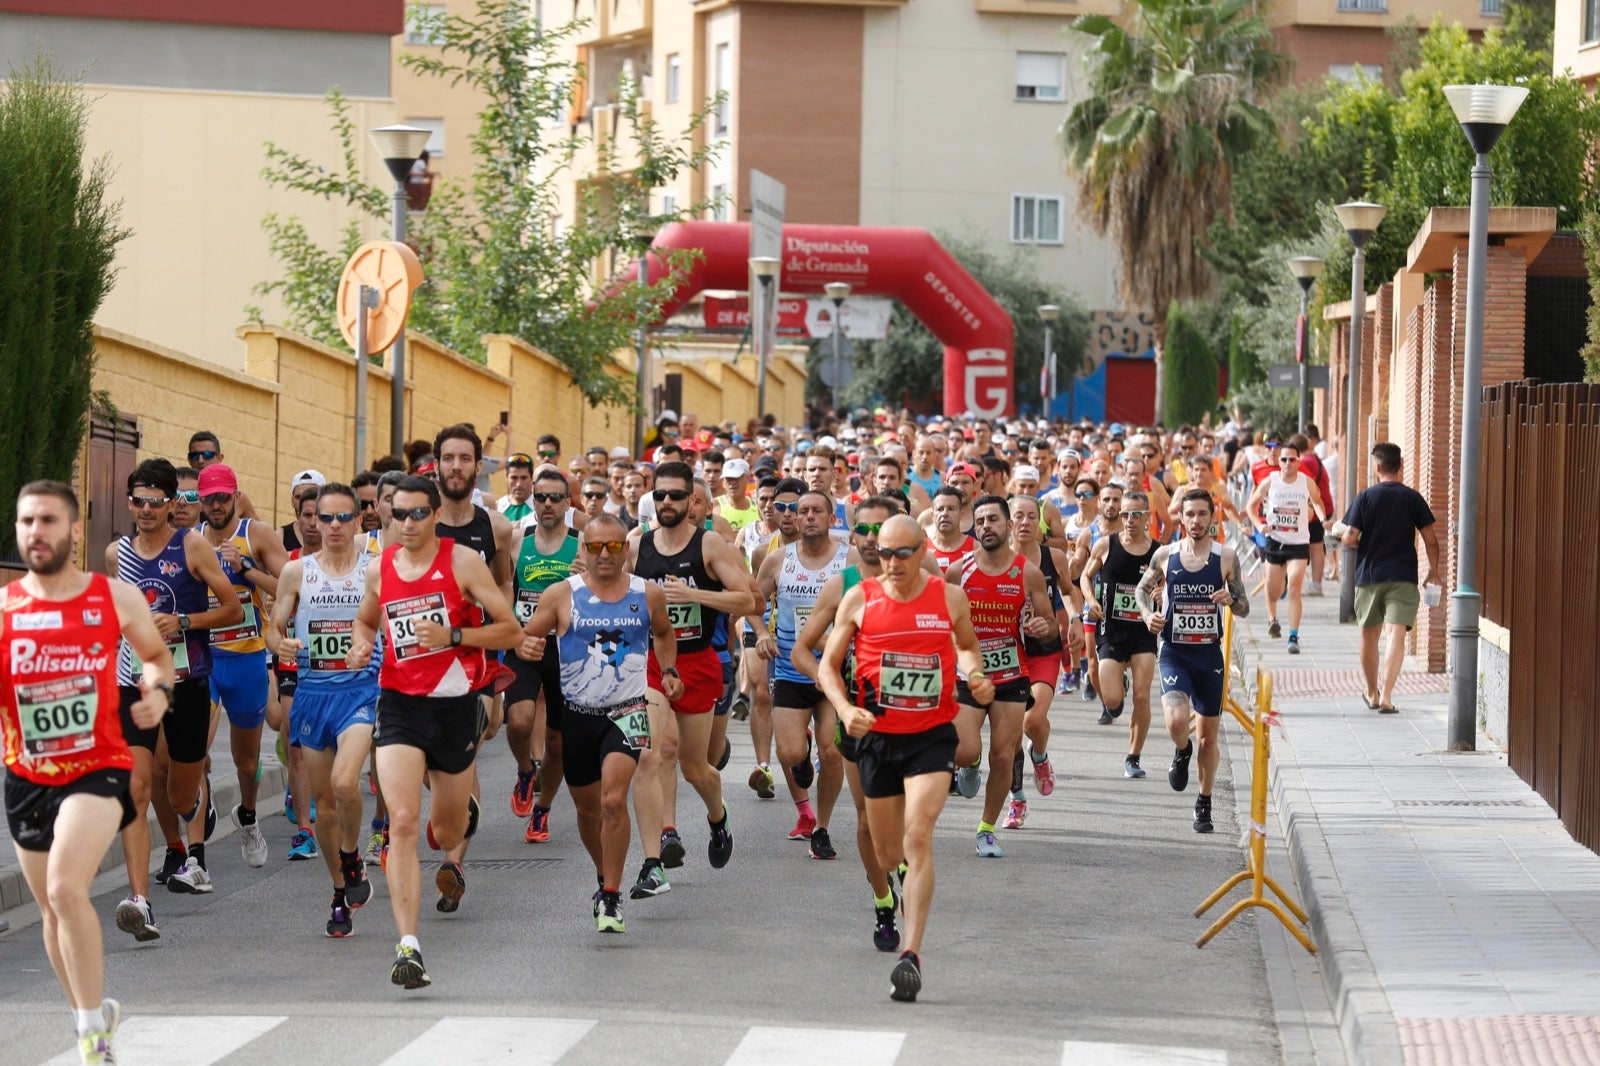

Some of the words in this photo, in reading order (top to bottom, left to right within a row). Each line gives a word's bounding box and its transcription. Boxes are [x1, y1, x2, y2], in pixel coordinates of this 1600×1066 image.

[786, 236, 869, 255] Diputación
[786, 257, 804, 272] de
[806, 258, 869, 274] Granada
[924, 271, 983, 331] DEPORTES
[1275, 514, 1298, 525] 3062
[785, 585, 822, 595] MARAC
[579, 618, 611, 627] TODO
[613, 618, 642, 626] SUMA
[1178, 615, 1214, 629] 3033
[11, 637, 109, 676] Polisalud
[41, 643, 82, 655] Clínicas
[890, 671, 935, 693] 477
[33, 700, 89, 733] 606
